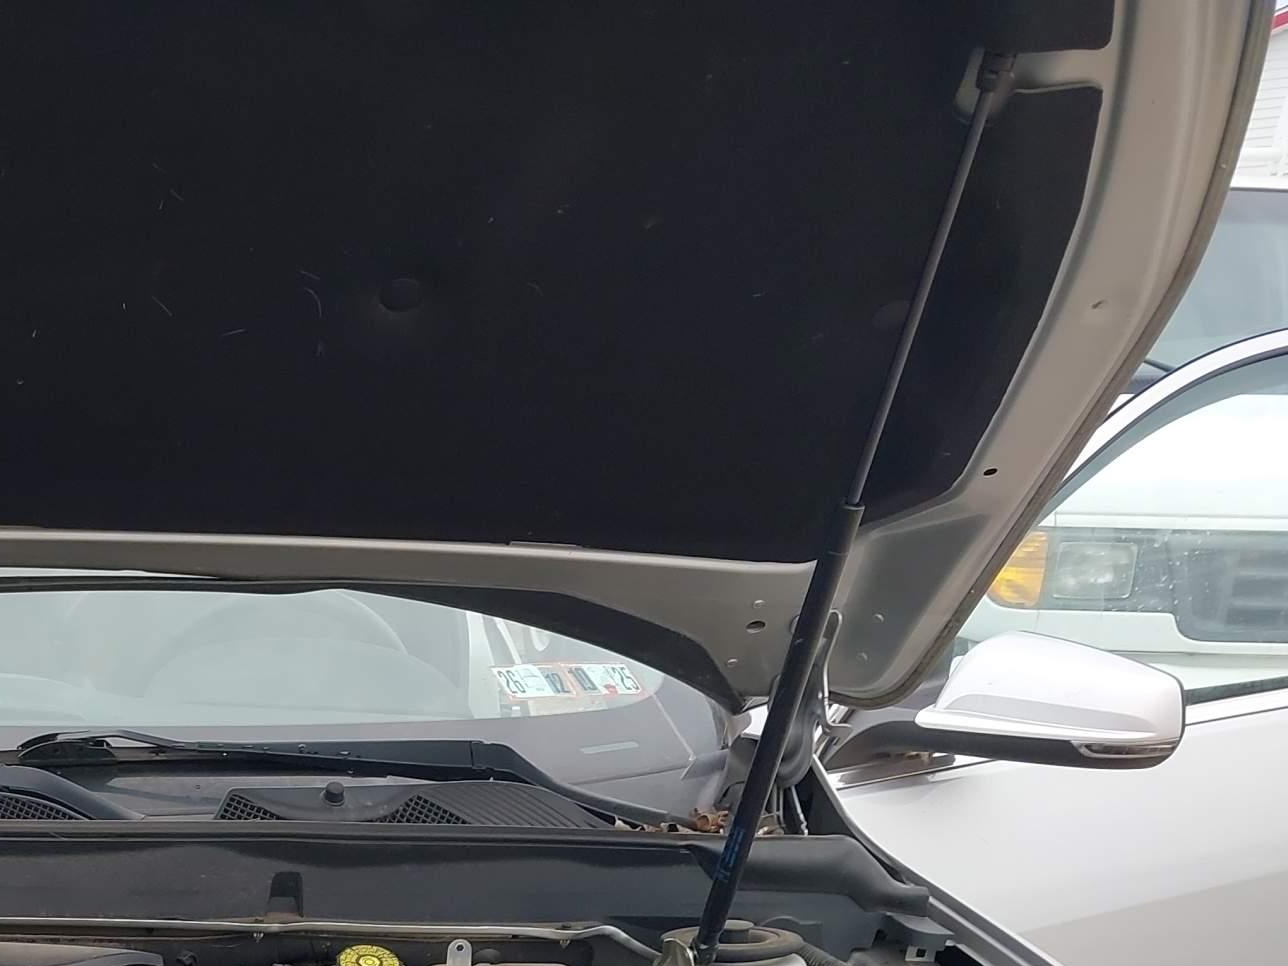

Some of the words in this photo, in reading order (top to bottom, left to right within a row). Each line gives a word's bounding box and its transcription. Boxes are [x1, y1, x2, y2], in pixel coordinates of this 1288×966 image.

[497, 670, 527, 694] 26
[544, 672, 572, 694] 12
[611, 666, 640, 691] 25
